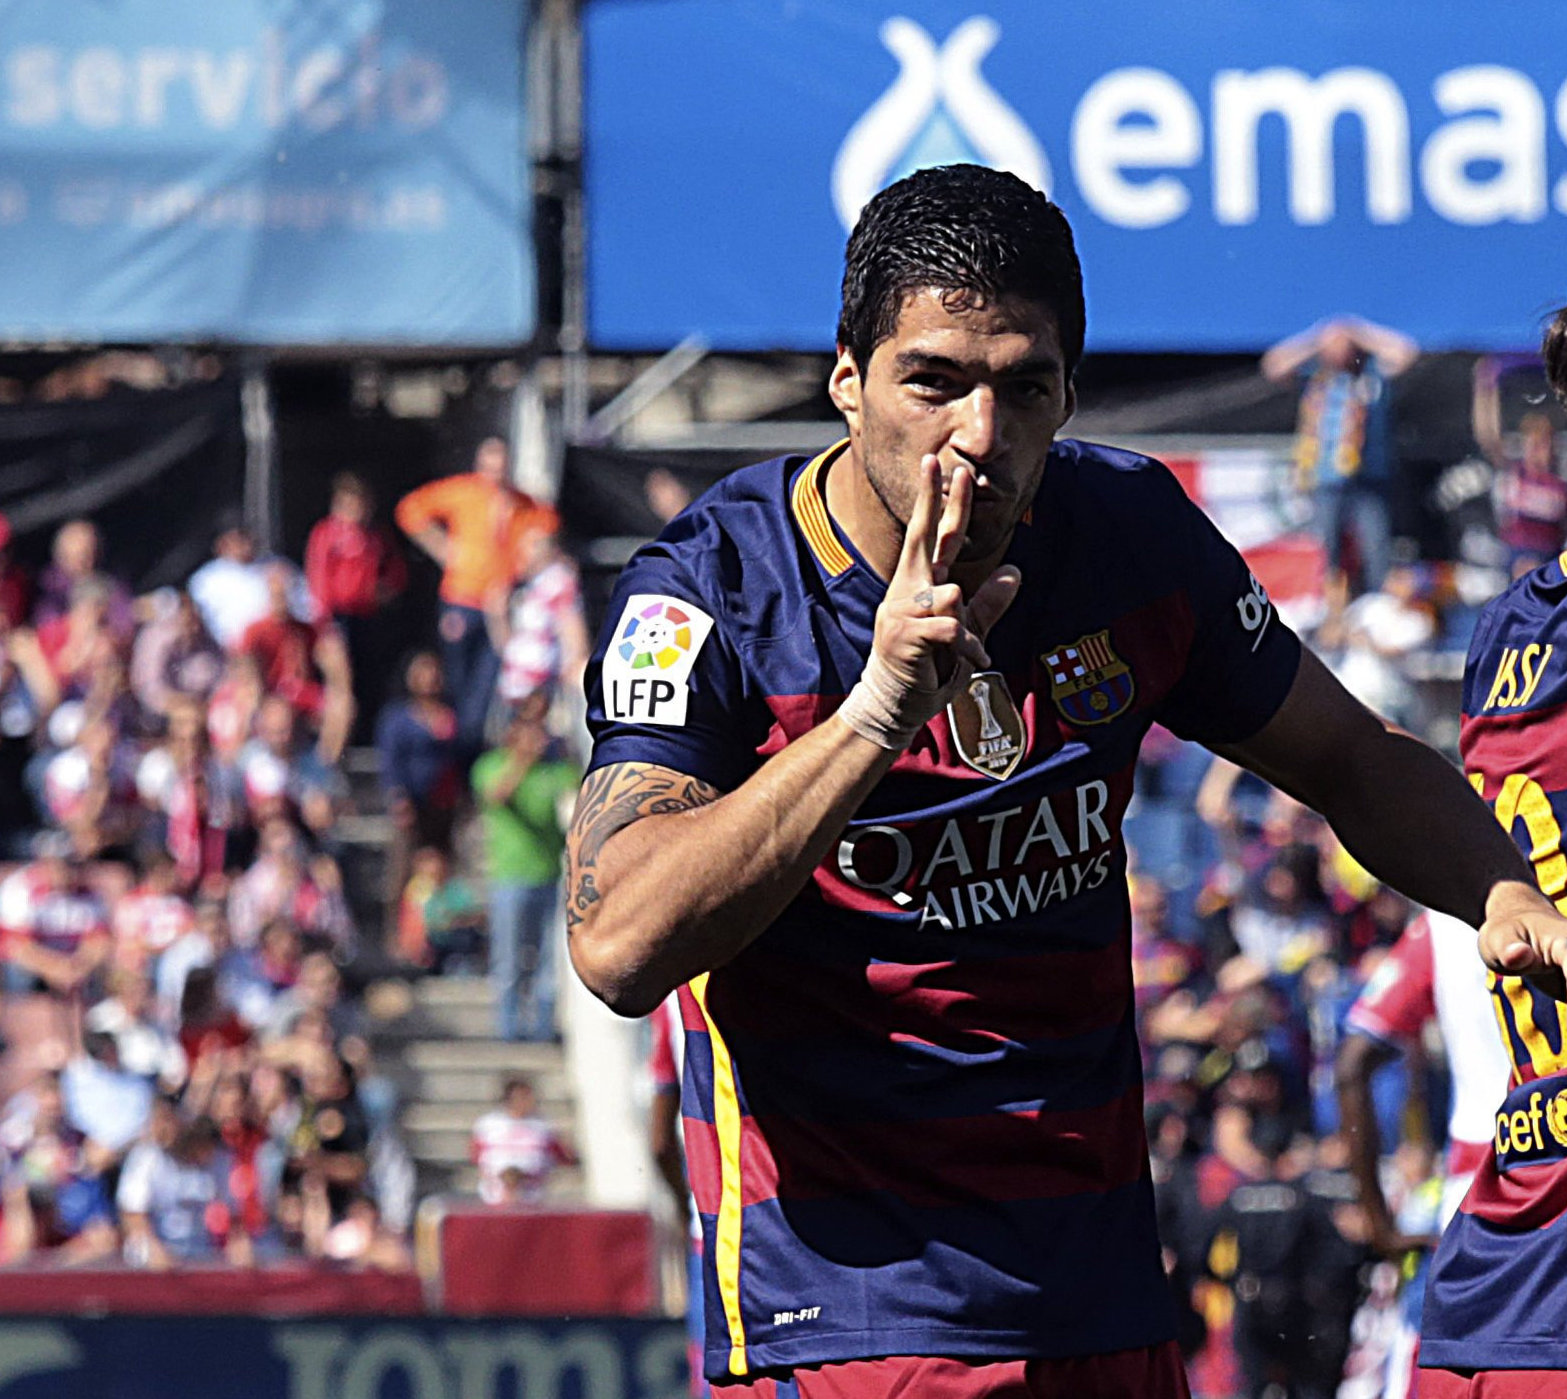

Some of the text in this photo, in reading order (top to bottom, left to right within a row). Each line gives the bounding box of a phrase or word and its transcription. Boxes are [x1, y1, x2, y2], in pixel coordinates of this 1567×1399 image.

[612, 679, 675, 718] LFP
[838, 779, 1111, 905] QATAR
[916, 850, 1111, 932] AIRWAYS
[773, 1306, 821, 1326] DRI-FIT
